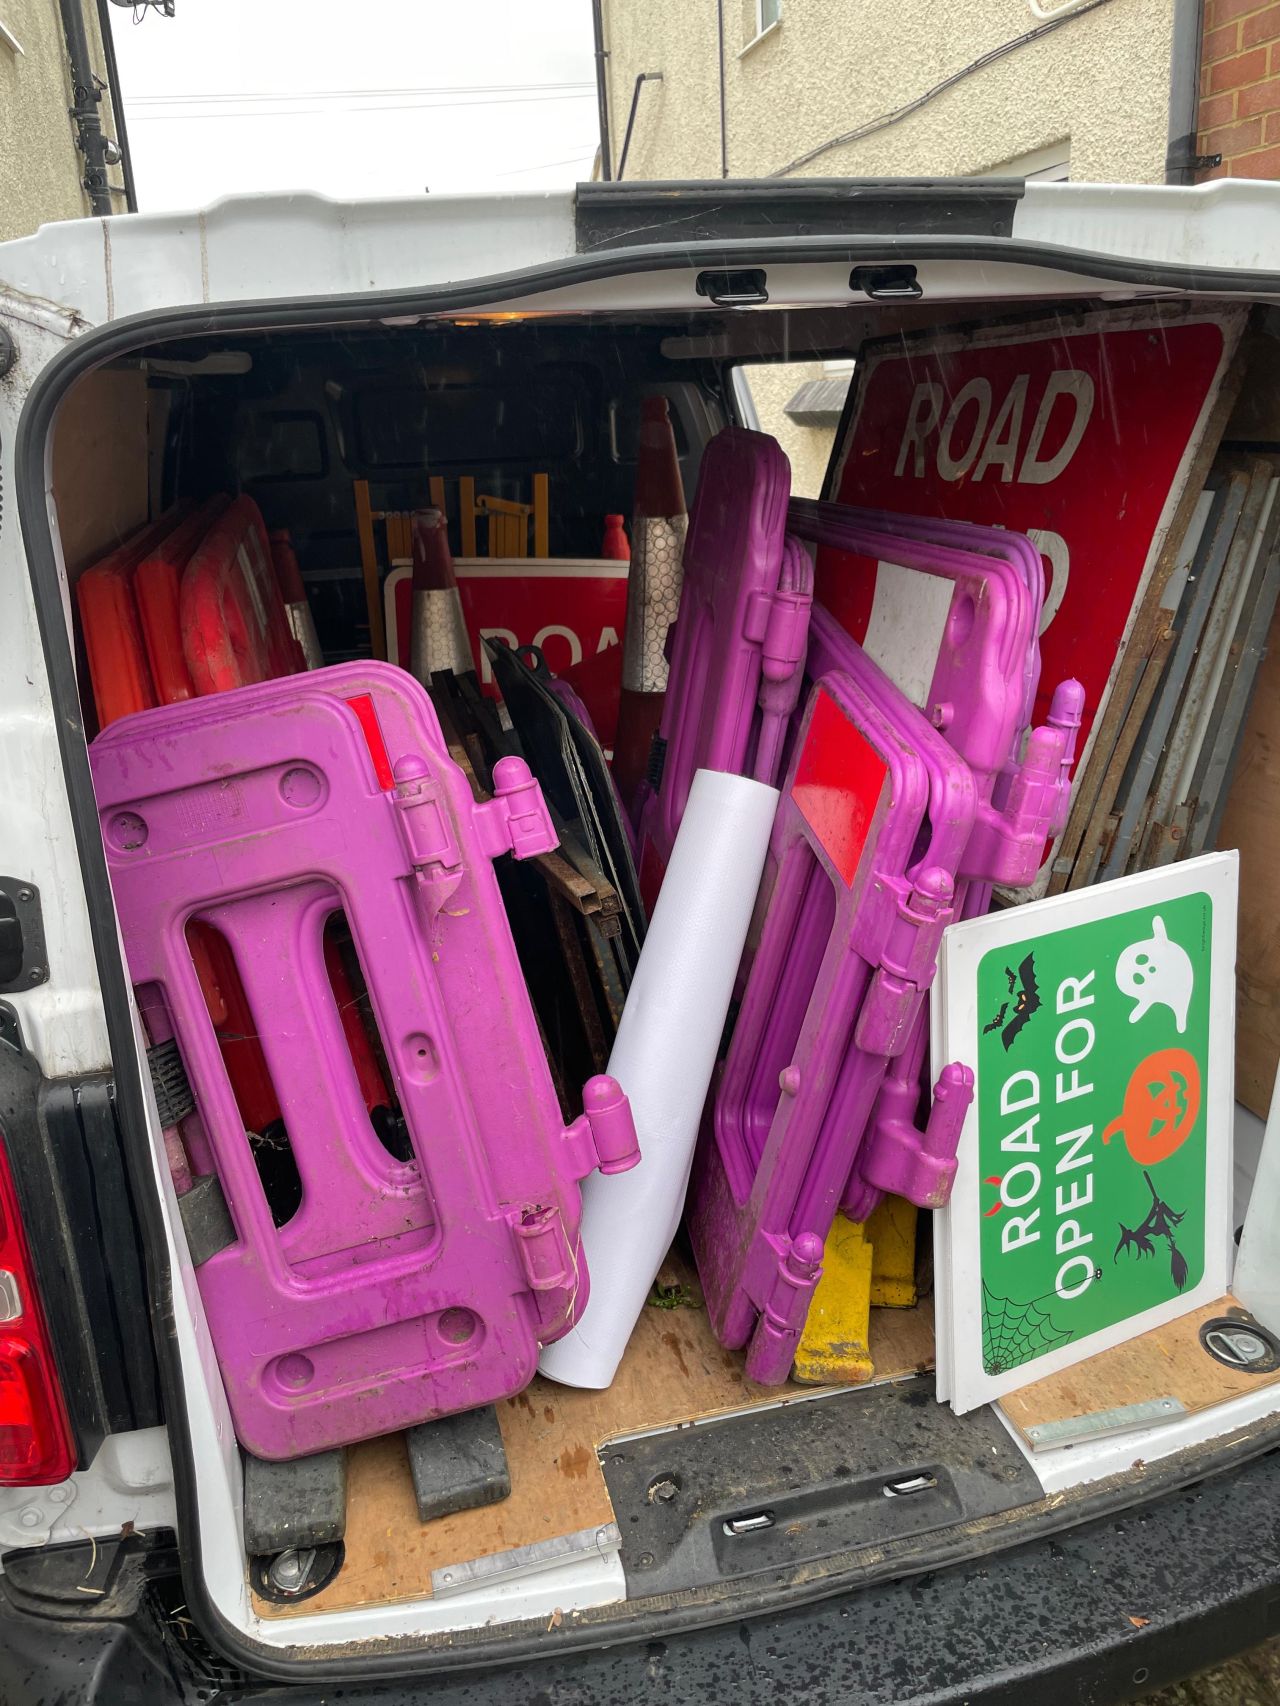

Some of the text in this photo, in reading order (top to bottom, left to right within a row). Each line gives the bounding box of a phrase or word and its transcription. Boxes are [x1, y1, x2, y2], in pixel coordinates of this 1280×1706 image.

[893, 369, 1096, 485] ROAD
[1000, 1070, 1041, 1254] ROAD
[1055, 969, 1096, 1300] OPEN FOR
